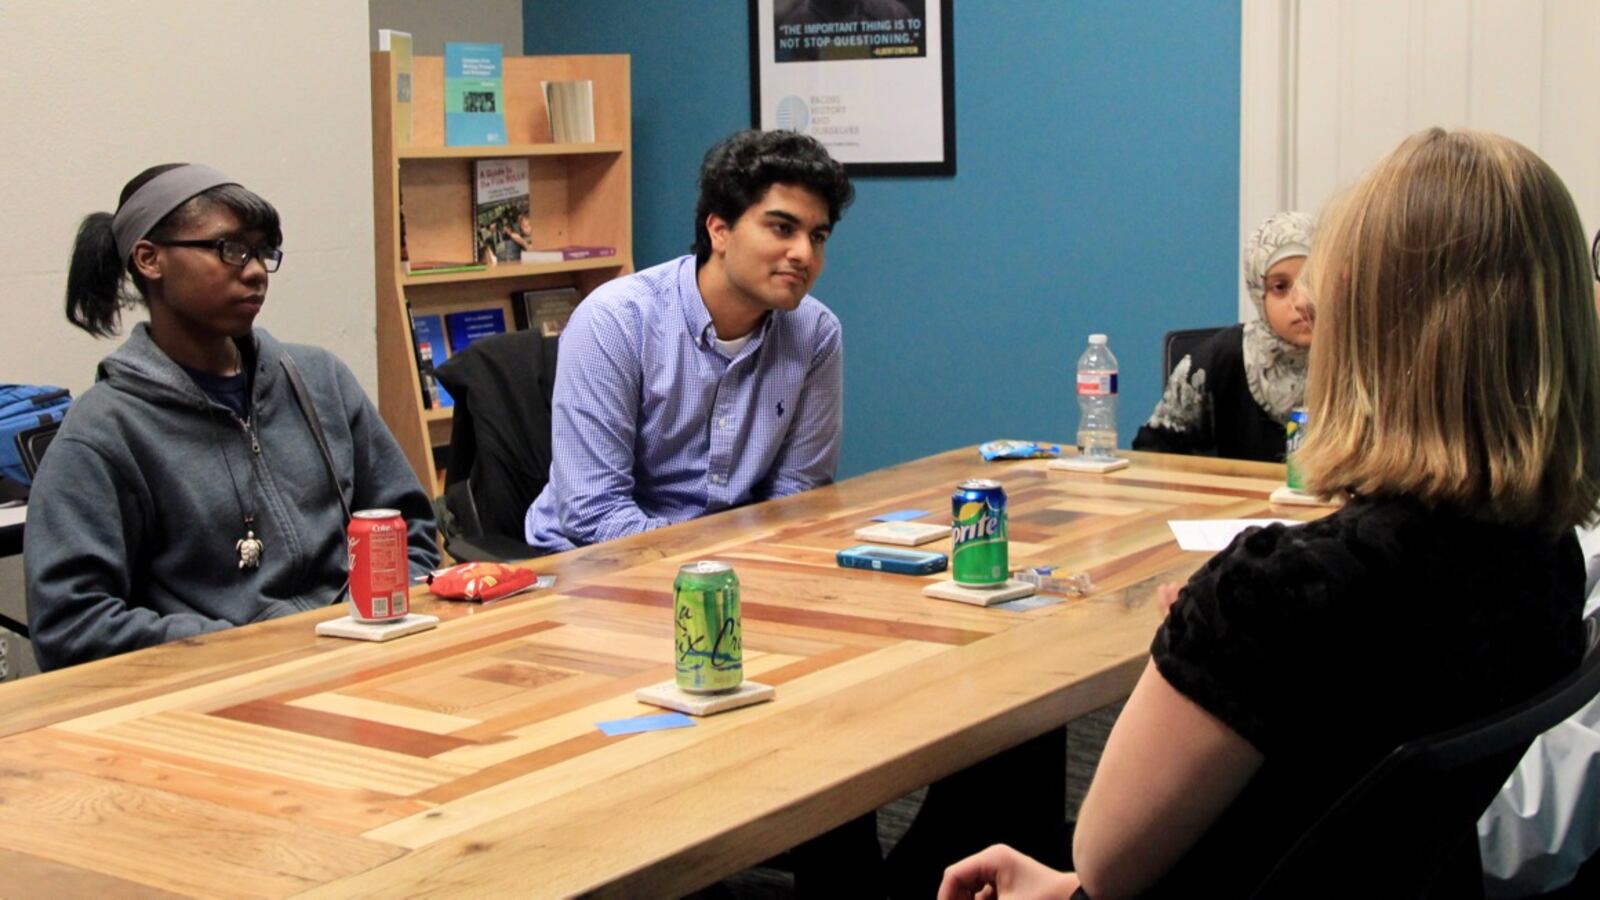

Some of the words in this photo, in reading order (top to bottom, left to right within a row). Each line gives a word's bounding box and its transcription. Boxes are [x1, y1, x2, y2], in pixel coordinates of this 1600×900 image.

[804, 22, 858, 34] IMPORTANT
[860, 20, 891, 32] THING
[894, 20, 904, 30] IS
[907, 18, 922, 30] TO
[779, 38, 800, 49] NOT
[803, 37, 831, 48] STOP
[951, 512, 998, 549] prite
